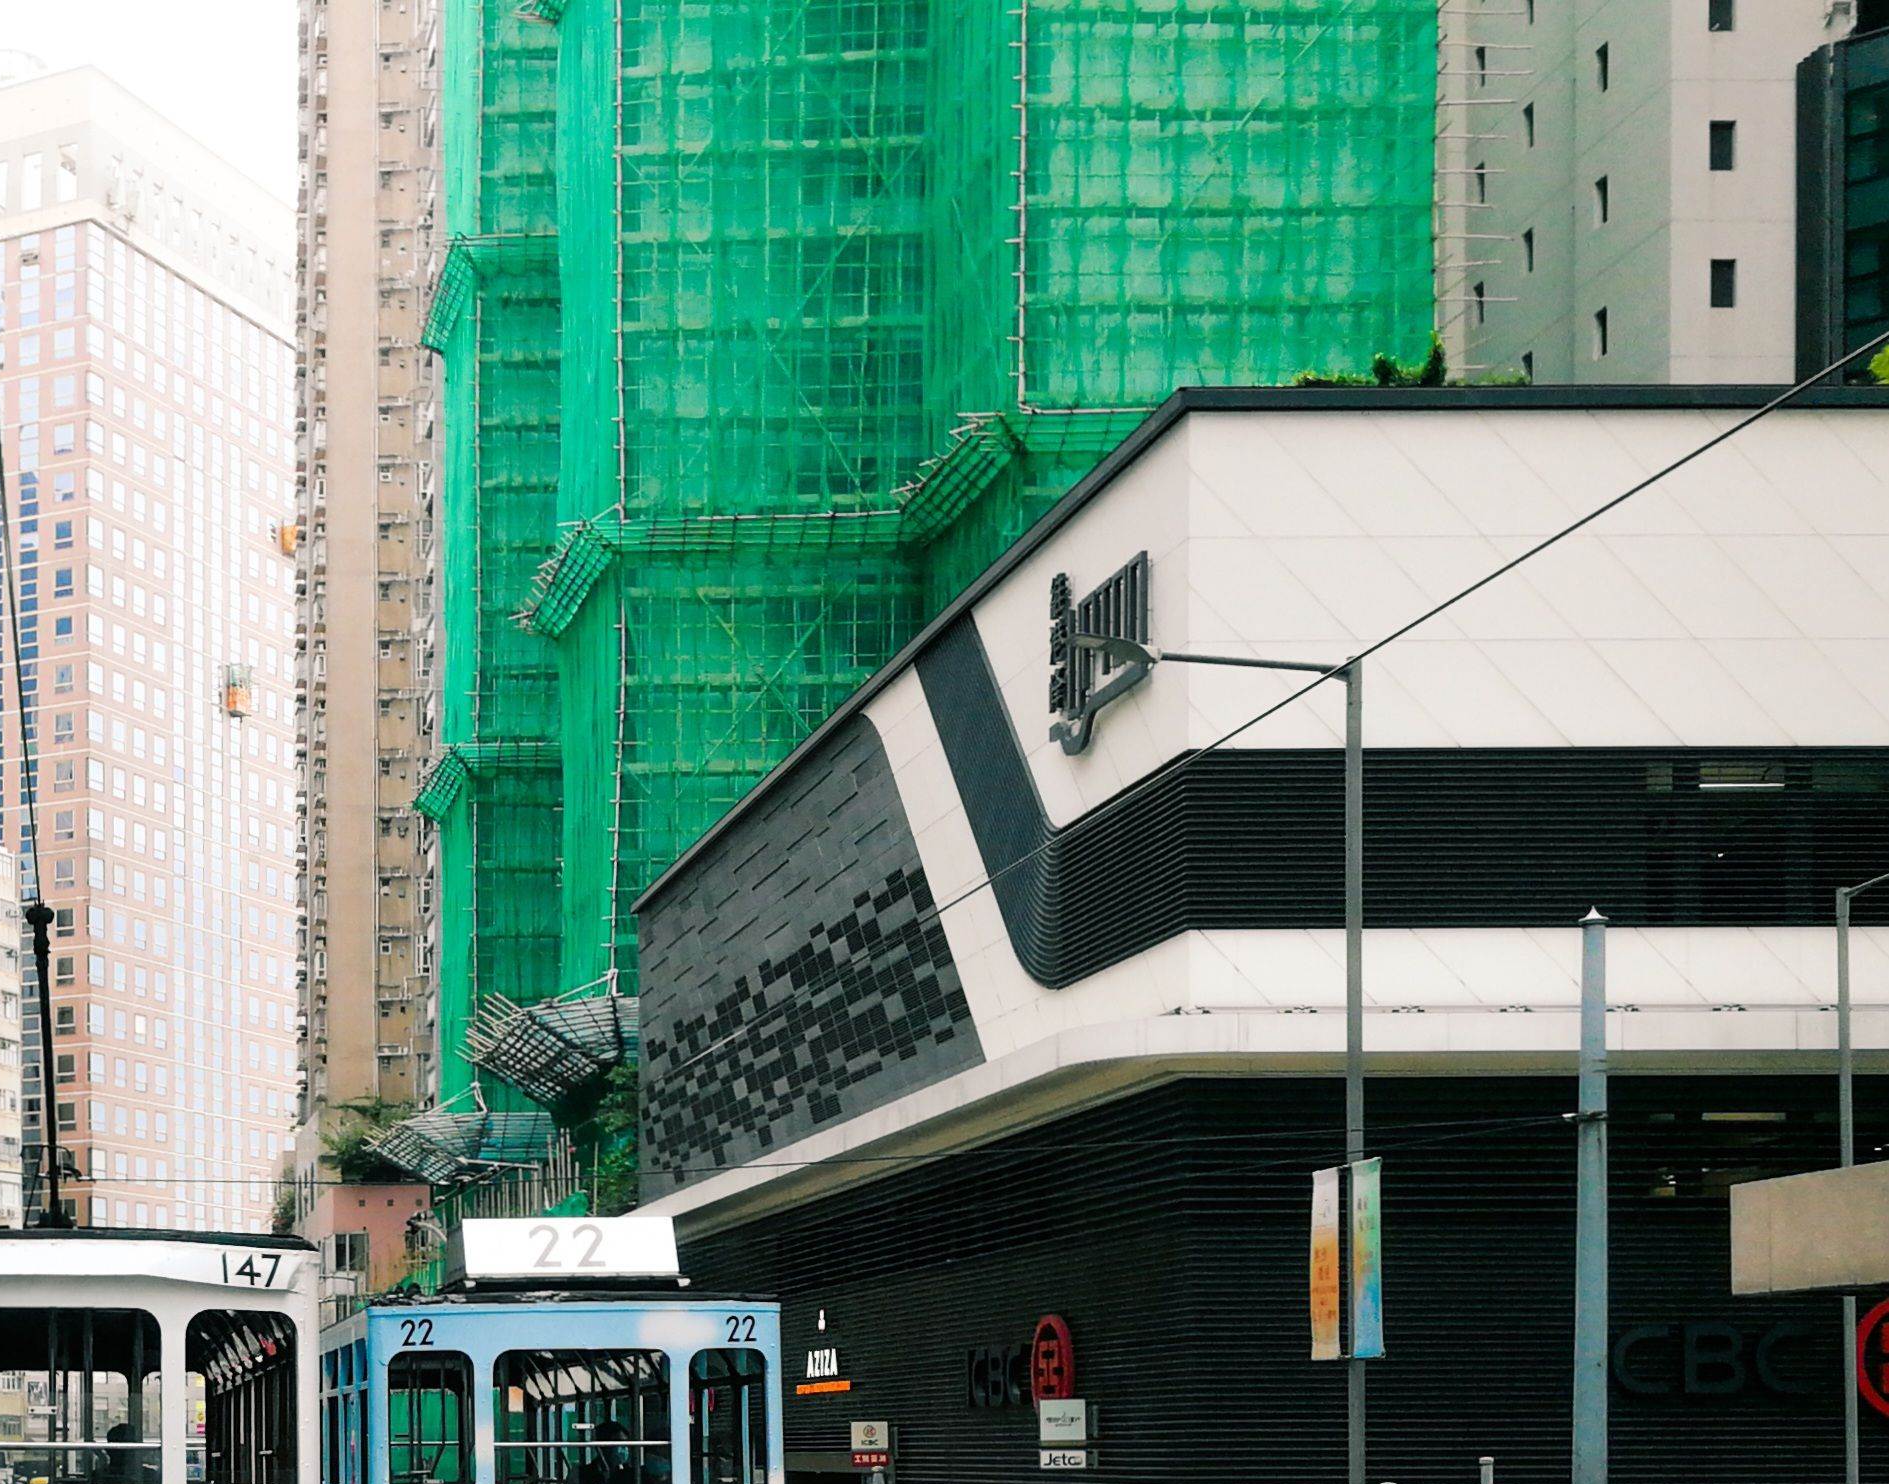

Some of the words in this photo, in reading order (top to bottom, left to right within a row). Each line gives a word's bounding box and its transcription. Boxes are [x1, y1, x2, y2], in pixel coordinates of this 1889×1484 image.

[529, 1224, 606, 1268] 22
[221, 1252, 282, 1287] 147
[400, 1319, 434, 1347] 22
[726, 1315, 757, 1343] 22
[806, 1348, 838, 1378] AZIZA
[1613, 1322, 1815, 1394] CBC
